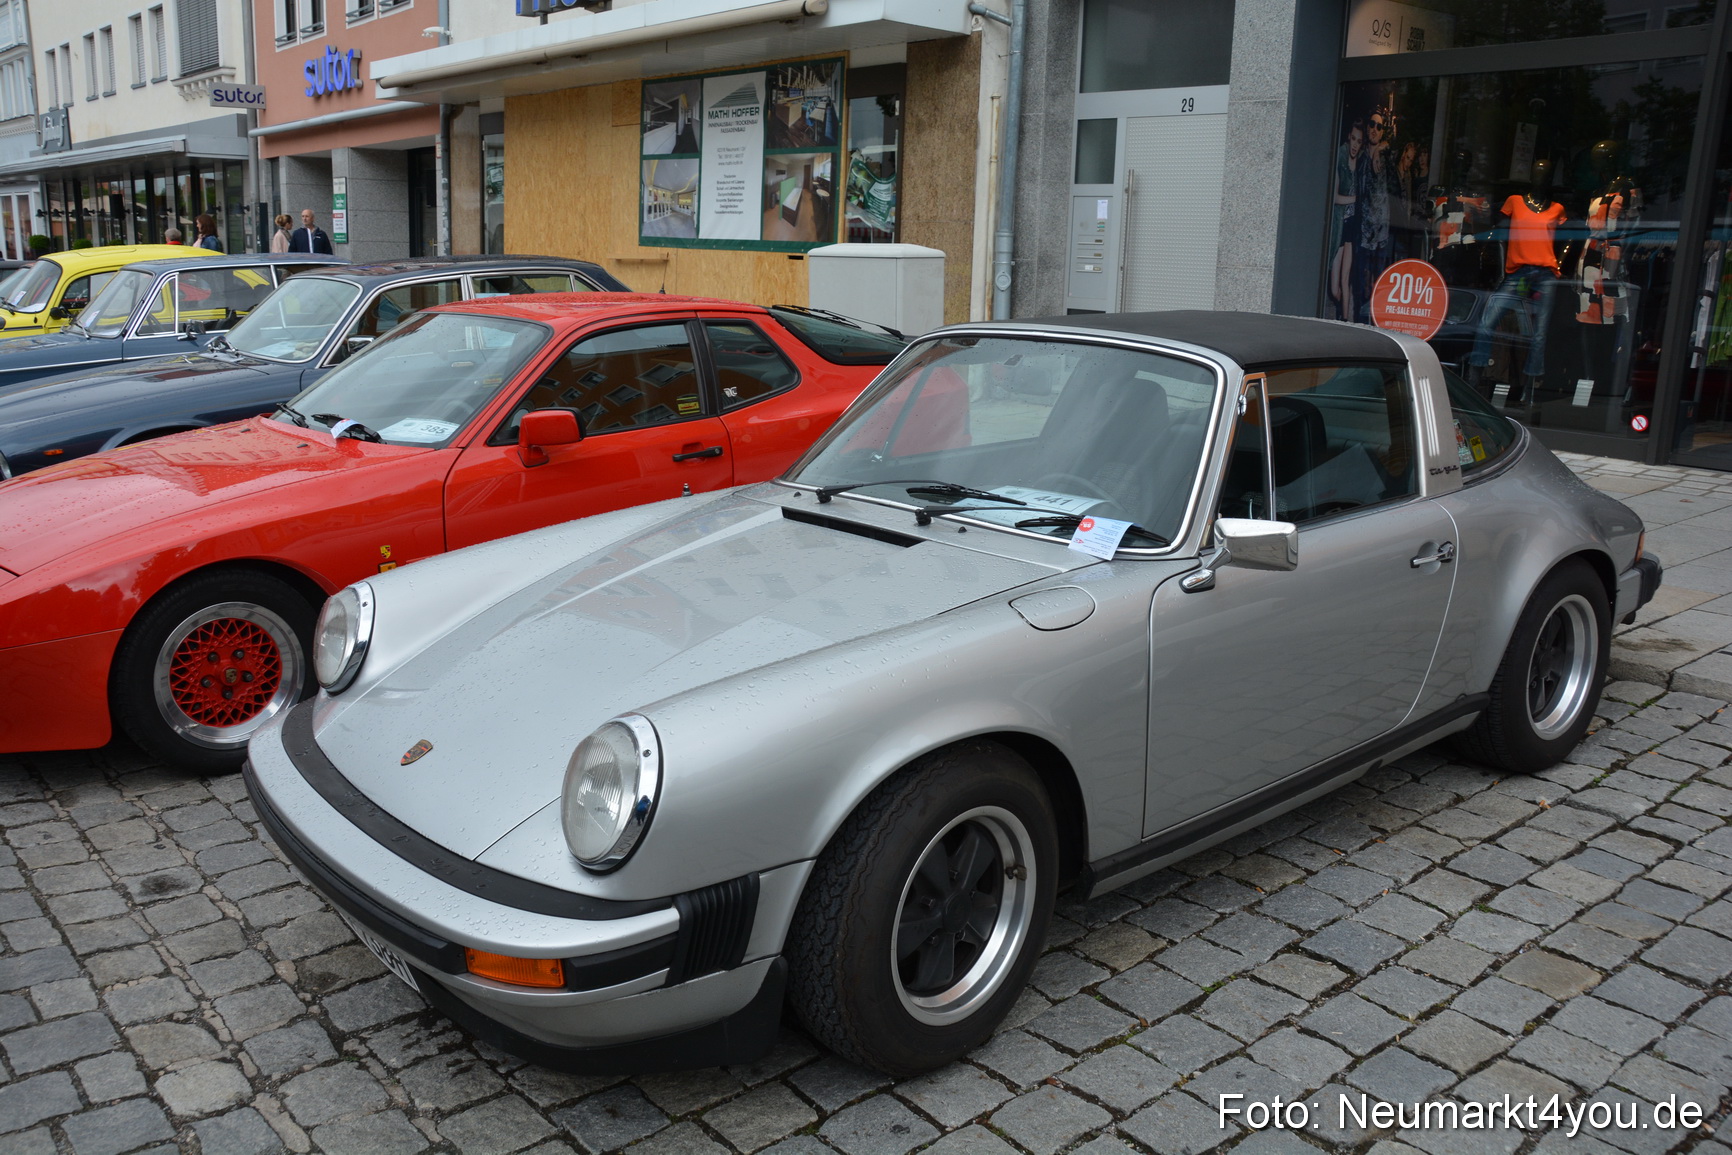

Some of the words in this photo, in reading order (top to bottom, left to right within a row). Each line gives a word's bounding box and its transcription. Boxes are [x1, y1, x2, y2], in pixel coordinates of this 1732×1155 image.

[1181, 97, 1194, 113] 29
[708, 109, 730, 120] MATHI
[732, 106, 760, 118] HOFFER
[1387, 273, 1433, 304] 20%
[1385, 305, 1410, 315] PRE-SALE
[1410, 307, 1431, 317] RABATT
[421, 424, 448, 434] 385
